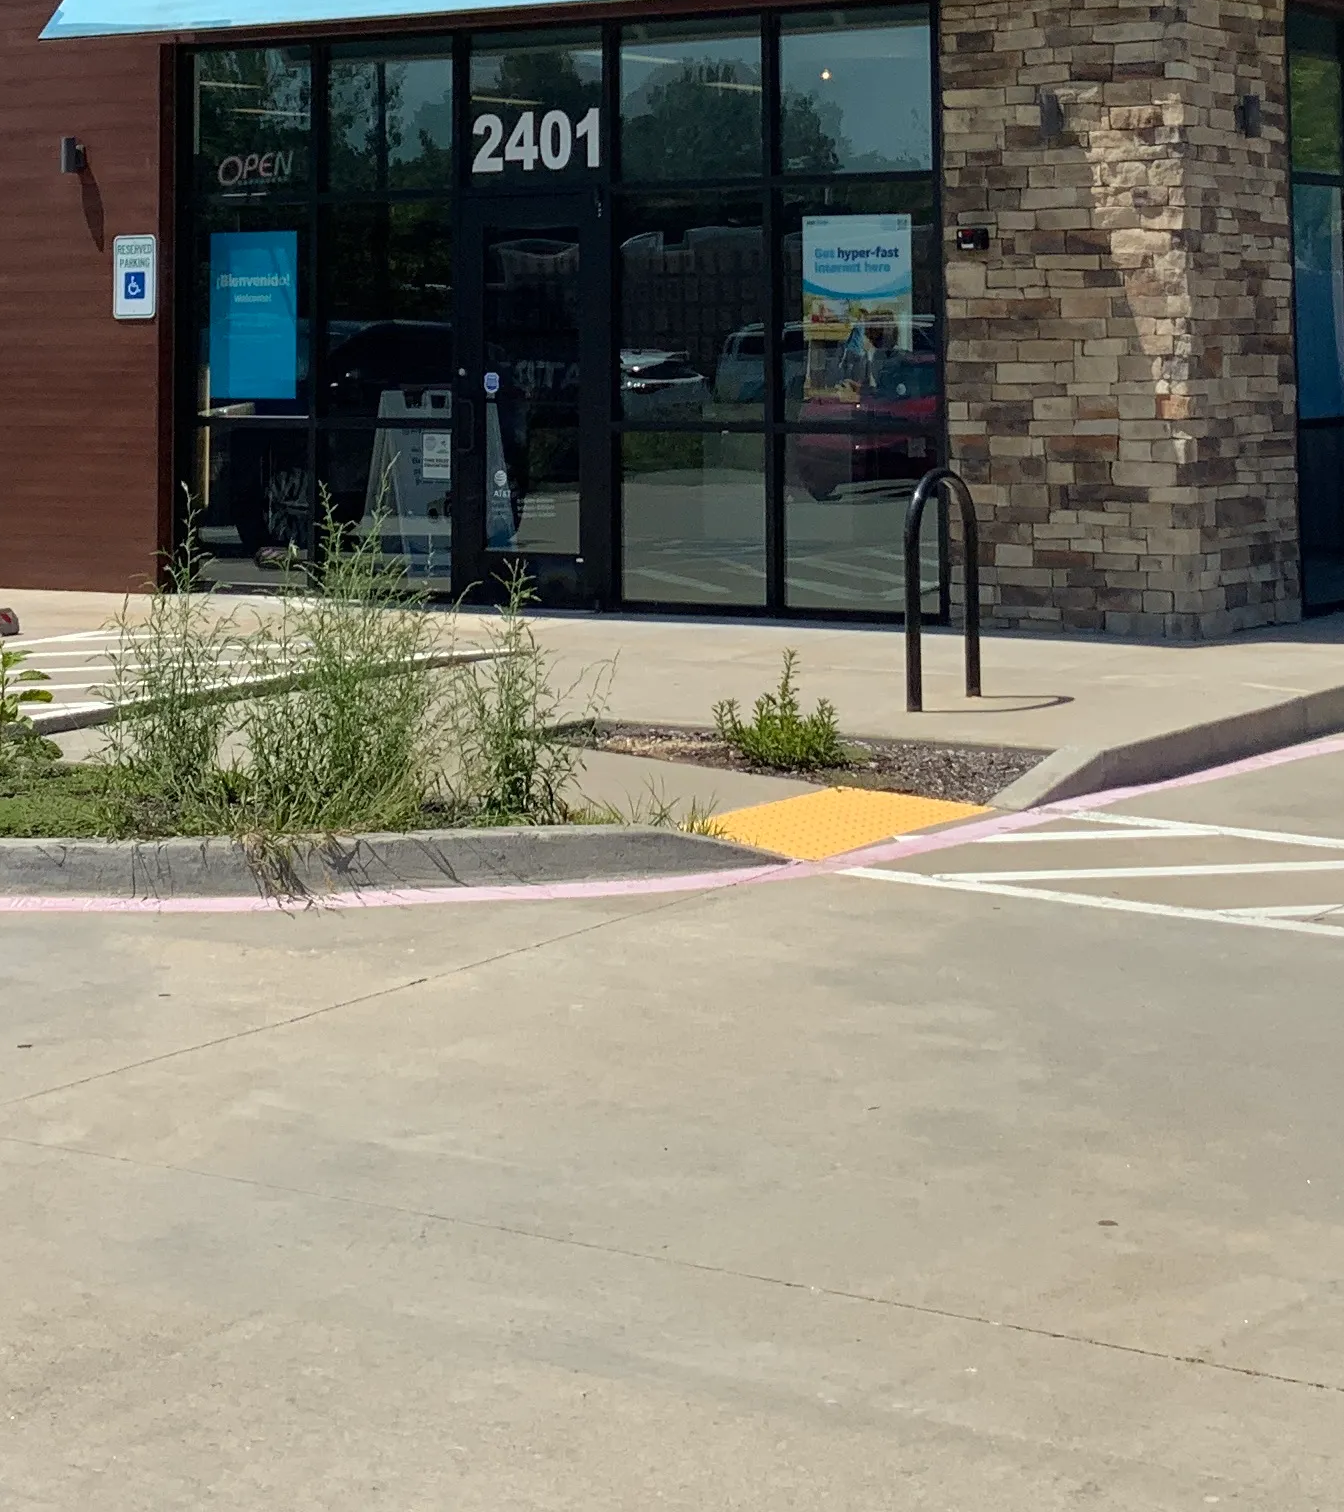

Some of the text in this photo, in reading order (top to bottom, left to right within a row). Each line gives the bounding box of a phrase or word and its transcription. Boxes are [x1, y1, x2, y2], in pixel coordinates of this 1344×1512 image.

[471, 107, 600, 173] 2401
[218, 150, 293, 186] OPEN
[117, 244, 153, 255] RESERVED
[837, 245, 900, 261] hyper-fast
[119, 258, 151, 269] PARKING
